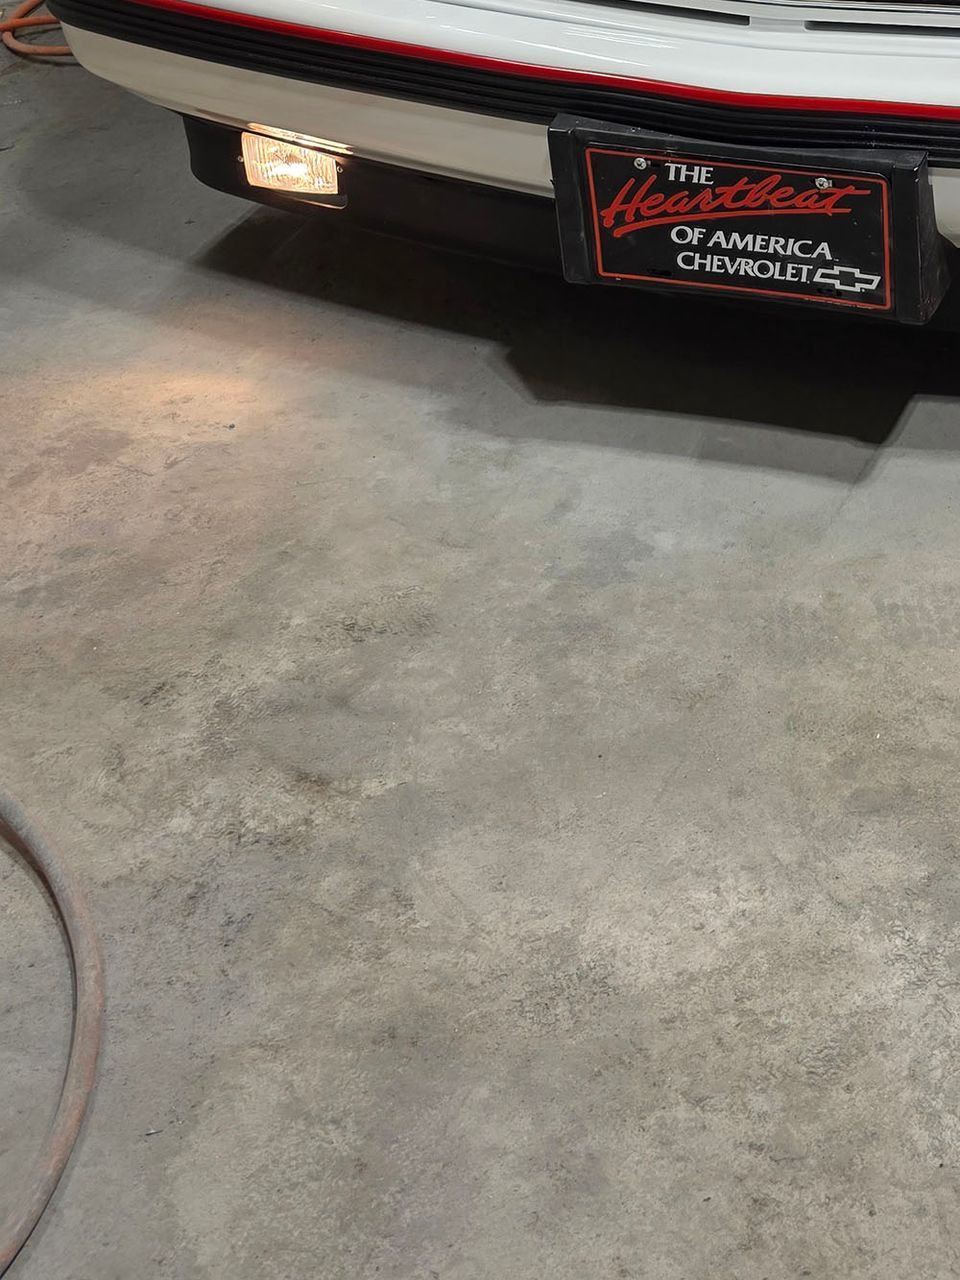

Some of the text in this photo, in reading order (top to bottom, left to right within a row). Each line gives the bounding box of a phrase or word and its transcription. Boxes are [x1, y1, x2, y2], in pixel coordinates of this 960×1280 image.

[665, 162, 714, 185] THE
[600, 174, 871, 228] Heartbeat
[670, 225, 833, 261] OF AMERICA
[676, 251, 814, 283] CHEVROLET
